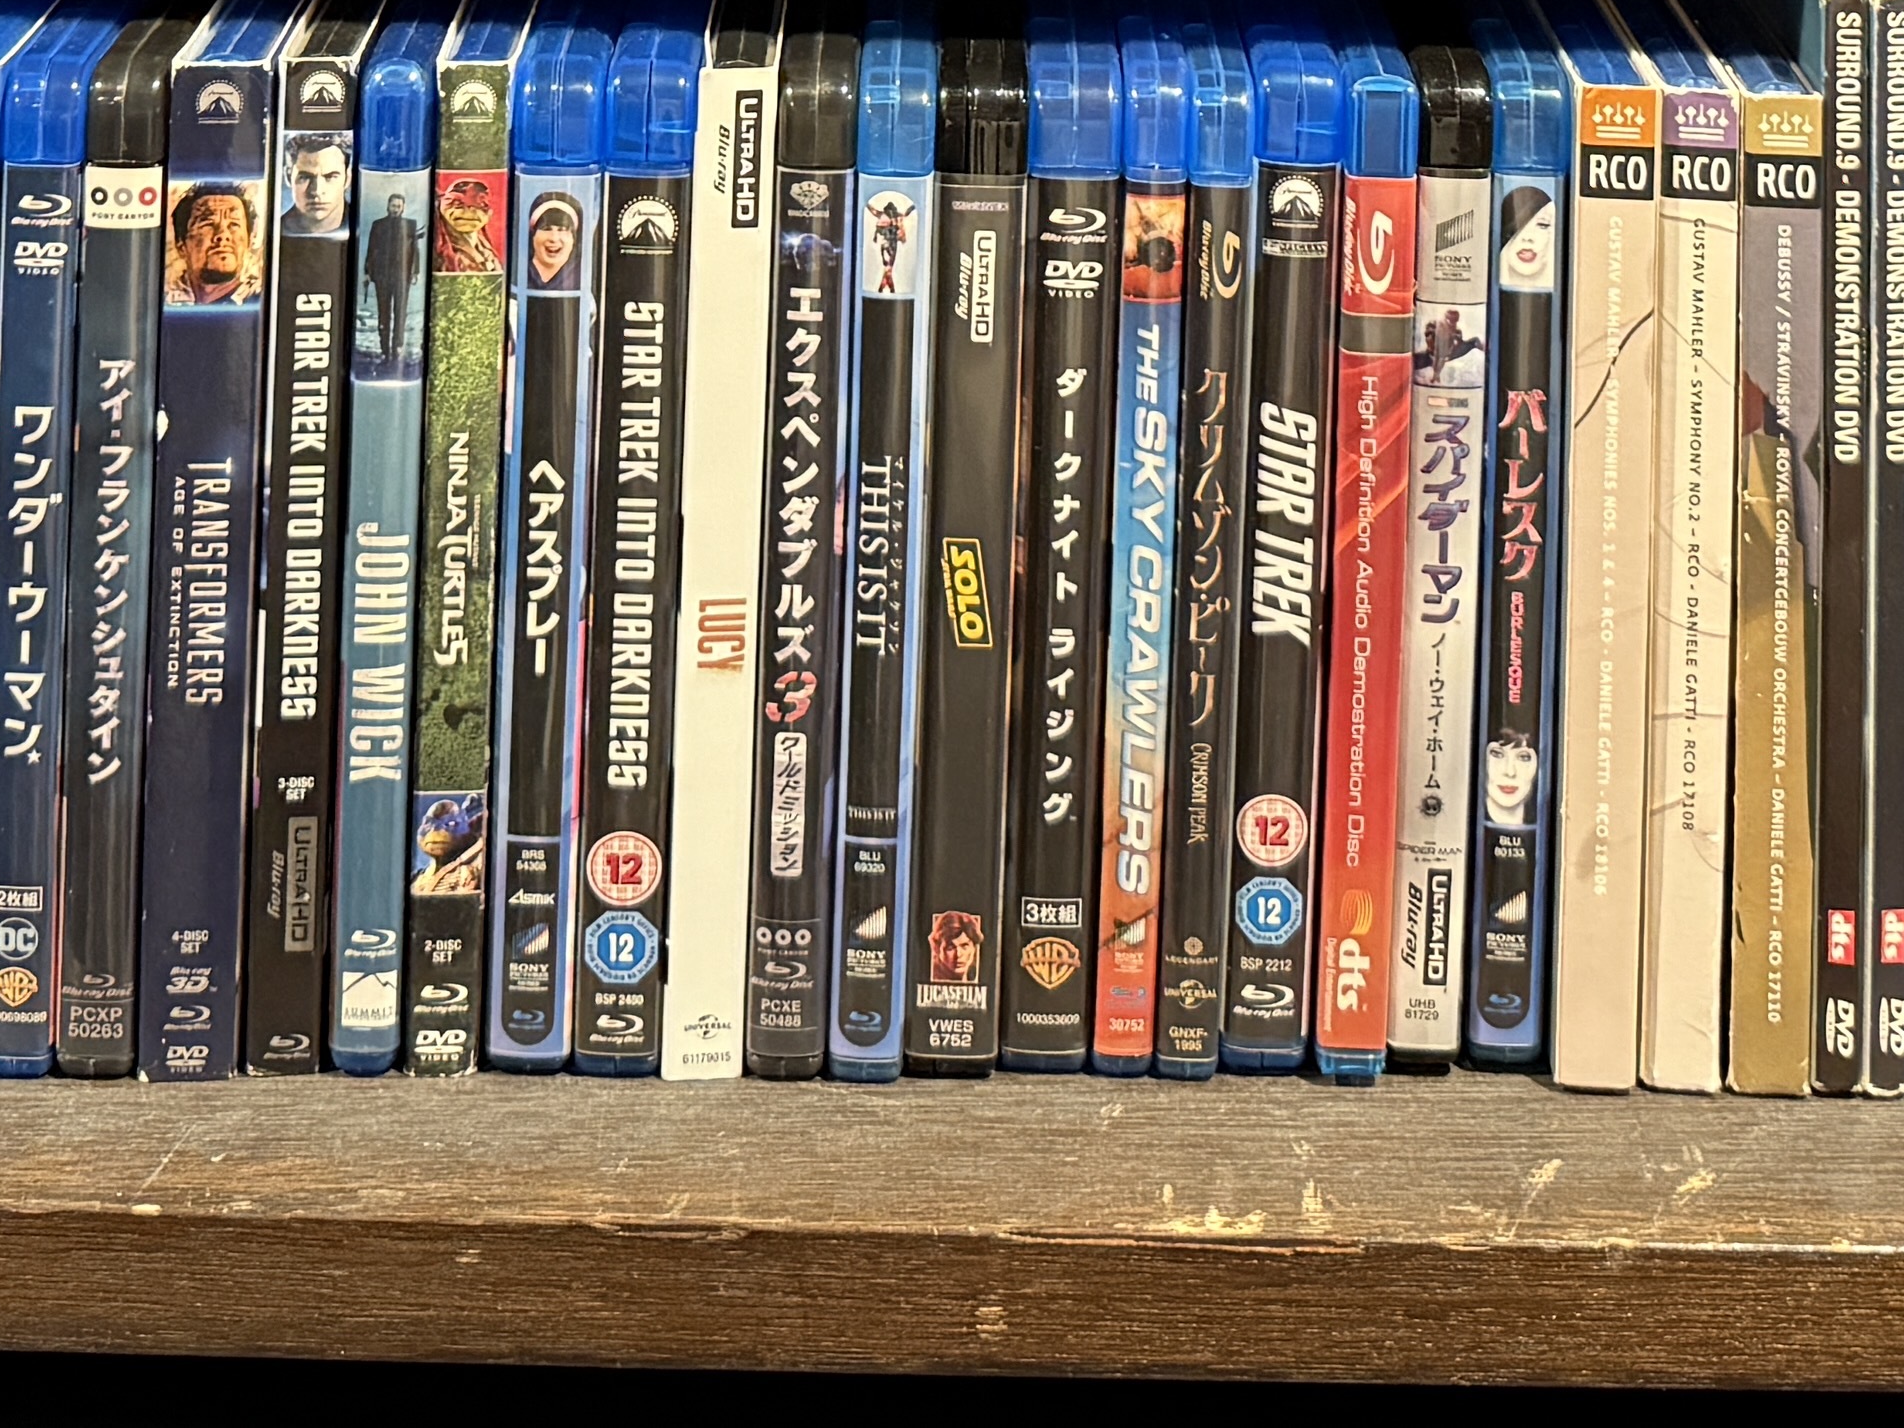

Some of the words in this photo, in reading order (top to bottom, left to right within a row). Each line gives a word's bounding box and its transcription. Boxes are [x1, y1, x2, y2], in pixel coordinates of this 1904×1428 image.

[1590, 156, 1647, 189] RCO
[1694, 218, 1705, 283] GUSTAV
[1835, 189, 1864, 400] DEMONSTRATION
[292, 292, 331, 367] STAR
[1135, 324, 1161, 404] THE
[1692, 288, 1704, 358] MAHLER
[290, 373, 330, 455] TREK
[1132, 406, 1163, 542] SKY
[1689, 377, 1702, 475] SYMPHONY
[1835, 410, 1858, 462] DVD
[287, 464, 326, 537] INTO
[1053, 368, 1089, 601] ダークナイト
[3, 404, 60, 759] ワンダーウーマン
[86, 359, 135, 785] アイ・フランケンシュタイン
[185, 457, 233, 706] TRANSFORMERS
[354, 521, 410, 644] JOHN
[526, 457, 571, 676] ヘアスプレー
[280, 545, 322, 720] DARKNESS
[697, 598, 747, 672] LUCY
[348, 664, 406, 782] WICK
[1043, 627, 1078, 823] ライジング
[1118, 543, 1163, 894] CRAWLERS
